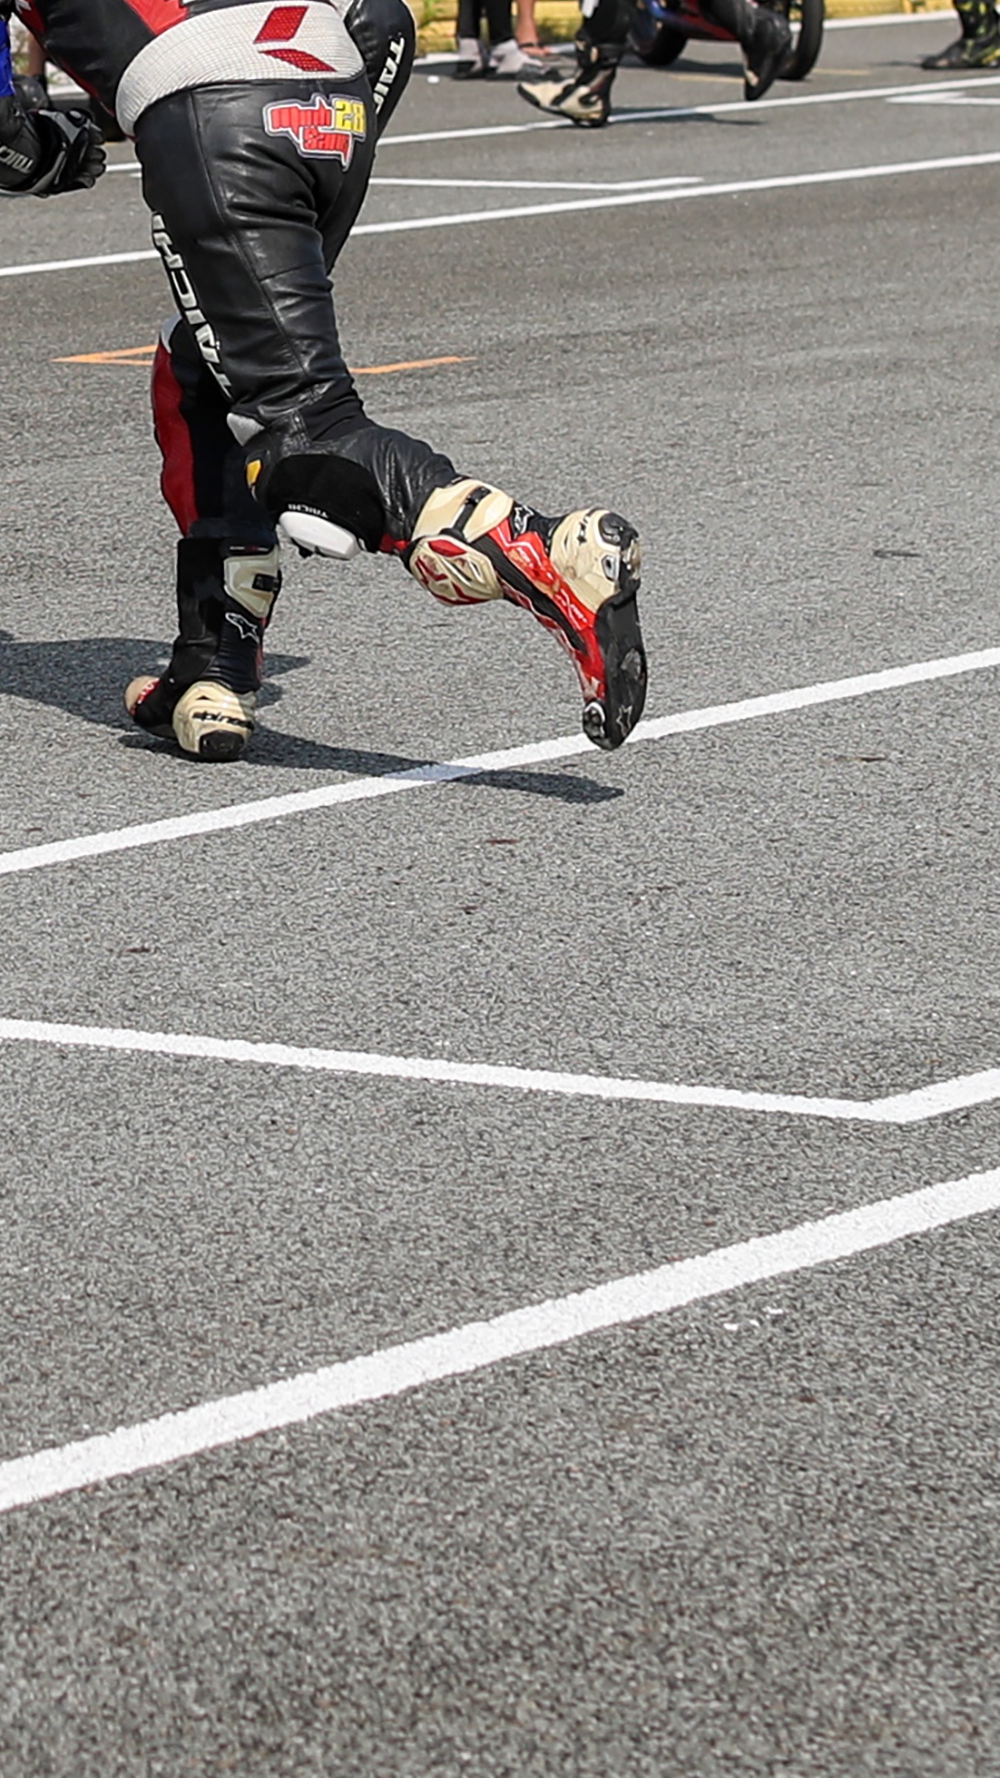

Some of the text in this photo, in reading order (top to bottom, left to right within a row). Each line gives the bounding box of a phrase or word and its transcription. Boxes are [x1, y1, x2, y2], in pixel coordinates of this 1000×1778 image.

[373, 37, 405, 115] TAIC
[335, 99, 365, 133] 28
[152, 214, 233, 399] TAICHI
